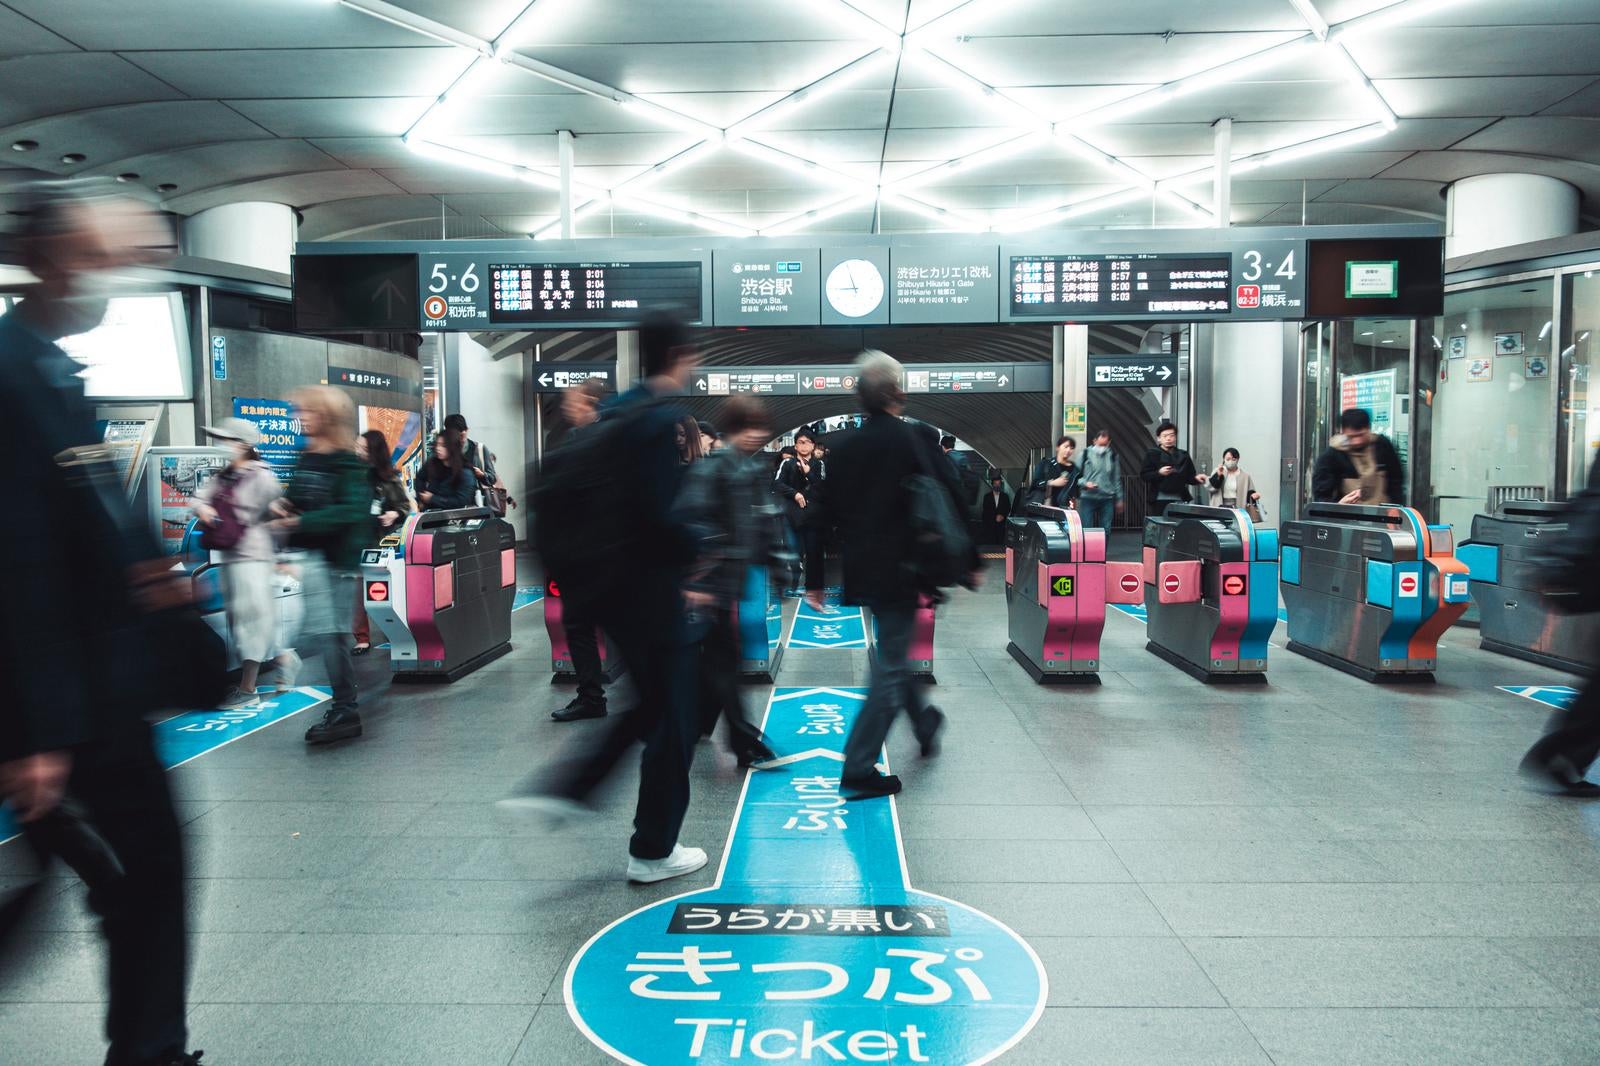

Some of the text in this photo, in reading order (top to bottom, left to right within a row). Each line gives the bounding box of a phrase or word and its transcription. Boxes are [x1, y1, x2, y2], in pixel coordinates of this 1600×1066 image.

[1111, 262, 1130, 271] 8:55
[586, 269, 604, 279] 9:01
[897, 266, 992, 279] 渋谷ヒカリエ1改札
[1111, 272, 1130, 281] 8:57
[586, 280, 605, 289] 9:04
[741, 278, 793, 295] 渋谷駅
[897, 280, 924, 289] Shibuya
[957, 279, 974, 287] Gate
[539, 290, 575, 300] 和光市
[586, 290, 605, 299] 9:09
[1111, 292, 1130, 302] 9:03
[543, 300, 571, 311] 志木
[586, 300, 604, 310] 9:11
[741, 296, 783, 306] Shibuya Sta.
[1261, 294, 1286, 307] 横浜
[448, 305, 476, 318] 和光市
[1111, 365, 1154, 373] ICカードチャージ
[349, 373, 391, 387] 東急PRボード
[240, 405, 288, 417] 東急線内限定
[1059, 582, 1069, 591] IC
[684, 907, 936, 932] うらが黒い
[674, 1017, 930, 1063] Ticket
